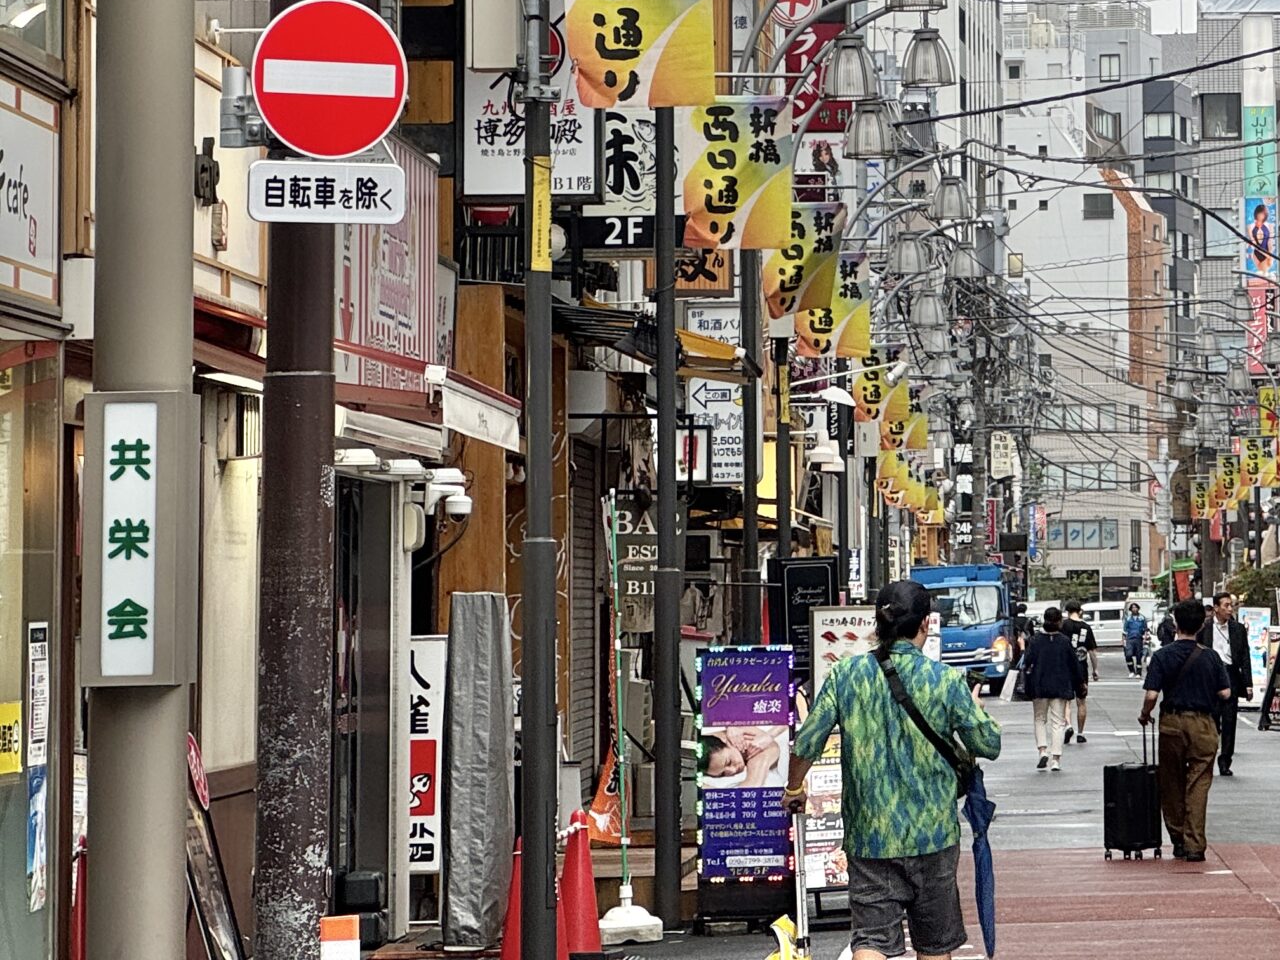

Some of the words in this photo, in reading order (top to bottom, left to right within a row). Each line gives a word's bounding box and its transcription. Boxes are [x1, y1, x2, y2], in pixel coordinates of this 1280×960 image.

[475, 118, 583, 147] 博多殿
[749, 107, 780, 165] 新橋
[7, 164, 29, 221] cafe
[264, 176, 393, 212] 自転車を除く
[554, 176, 592, 191] B1階
[703, 105, 740, 244] 西口通り
[604, 217, 644, 245] 2F
[813, 211, 835, 253] 新橋
[840, 260, 862, 300] 新橋
[107, 438, 151, 640] 共栄会
